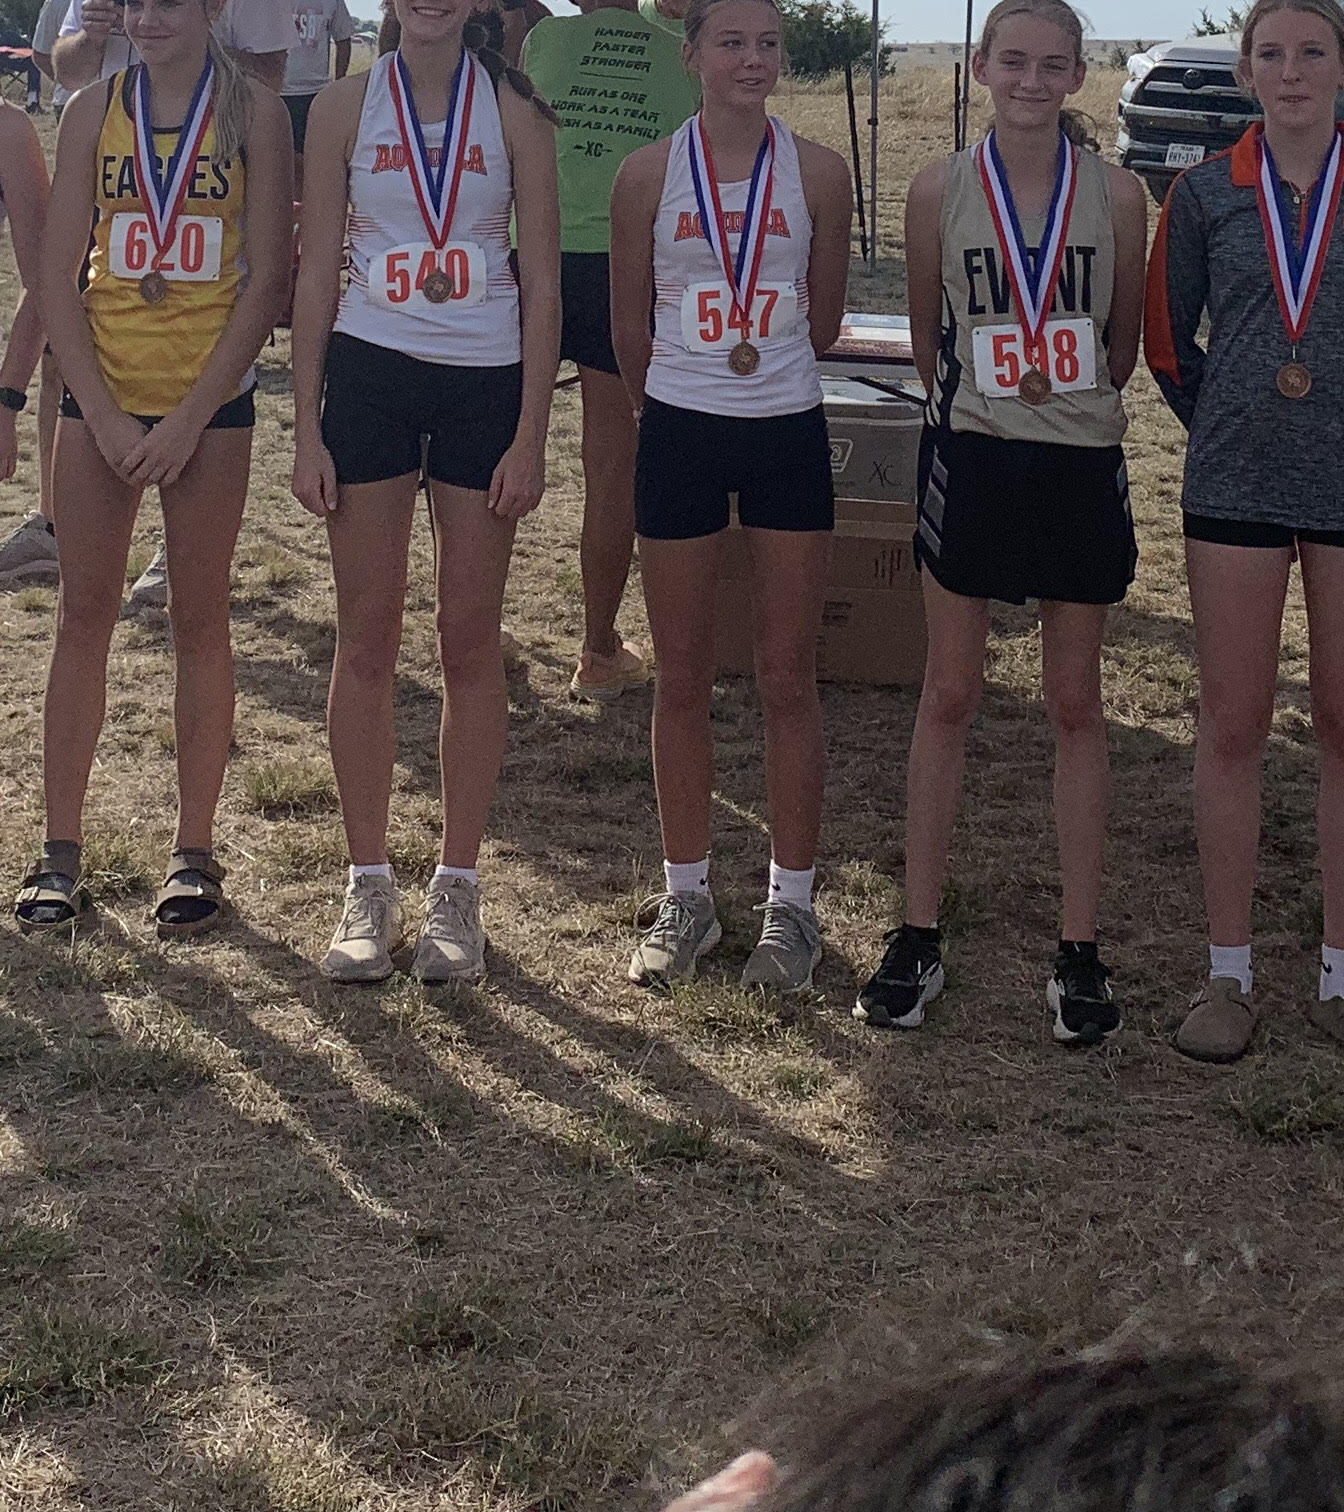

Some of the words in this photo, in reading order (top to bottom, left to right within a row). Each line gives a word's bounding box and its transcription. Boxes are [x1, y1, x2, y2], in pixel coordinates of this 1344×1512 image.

[579, 56, 652, 73] STRONGER
[569, 86, 597, 97] RUN
[597, 89, 619, 98] AS
[620, 91, 647, 104] ONE
[550, 99, 586, 112] WORK
[587, 104, 609, 115] AS
[609, 106, 619, 116] A
[623, 108, 661, 123] TEAM
[582, 120, 603, 130] AS
[603, 123, 614, 132] A
[697, 289, 780, 343] 547
